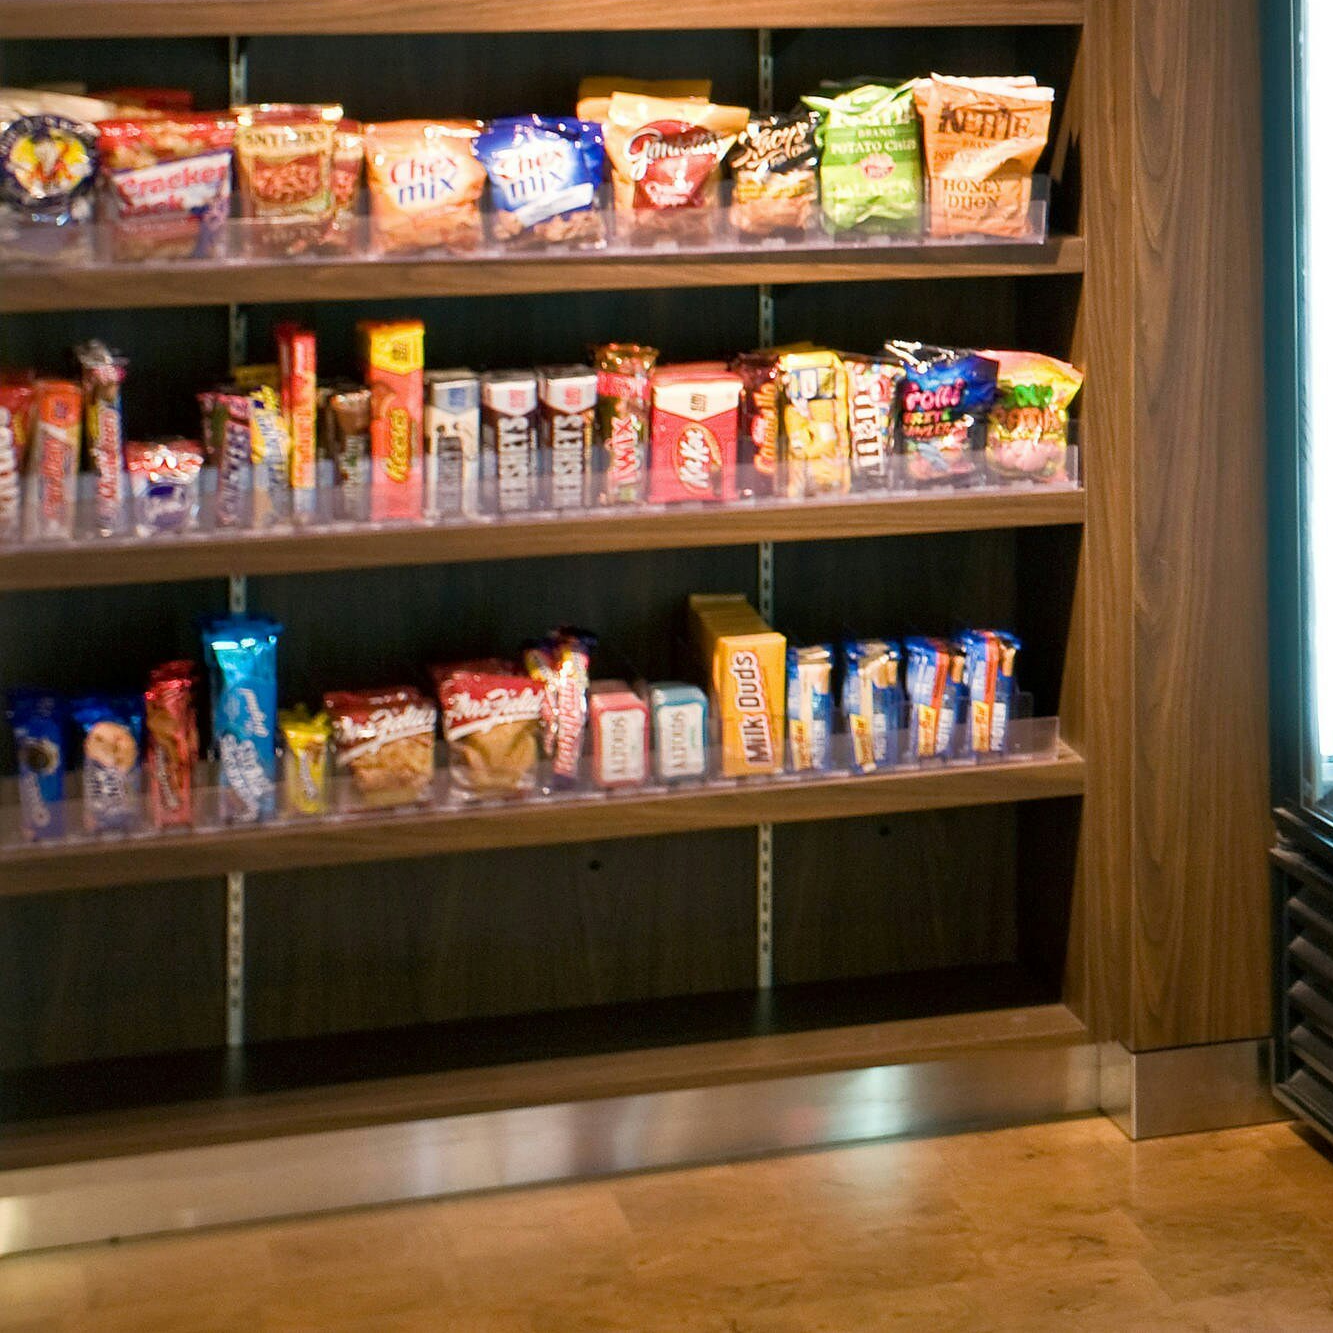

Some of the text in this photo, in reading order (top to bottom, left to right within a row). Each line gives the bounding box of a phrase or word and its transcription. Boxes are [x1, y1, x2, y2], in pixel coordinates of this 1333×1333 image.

[830, 142, 881, 155] POTATO
[119, 164, 229, 196] Cracker
[390, 156, 456, 185] Chex
[508, 169, 565, 200] mix
[397, 176, 456, 206] mix
[943, 178, 1004, 194] HONEY
[947, 193, 1001, 212] DIJON
[736, 654, 770, 764] Milk Duds
